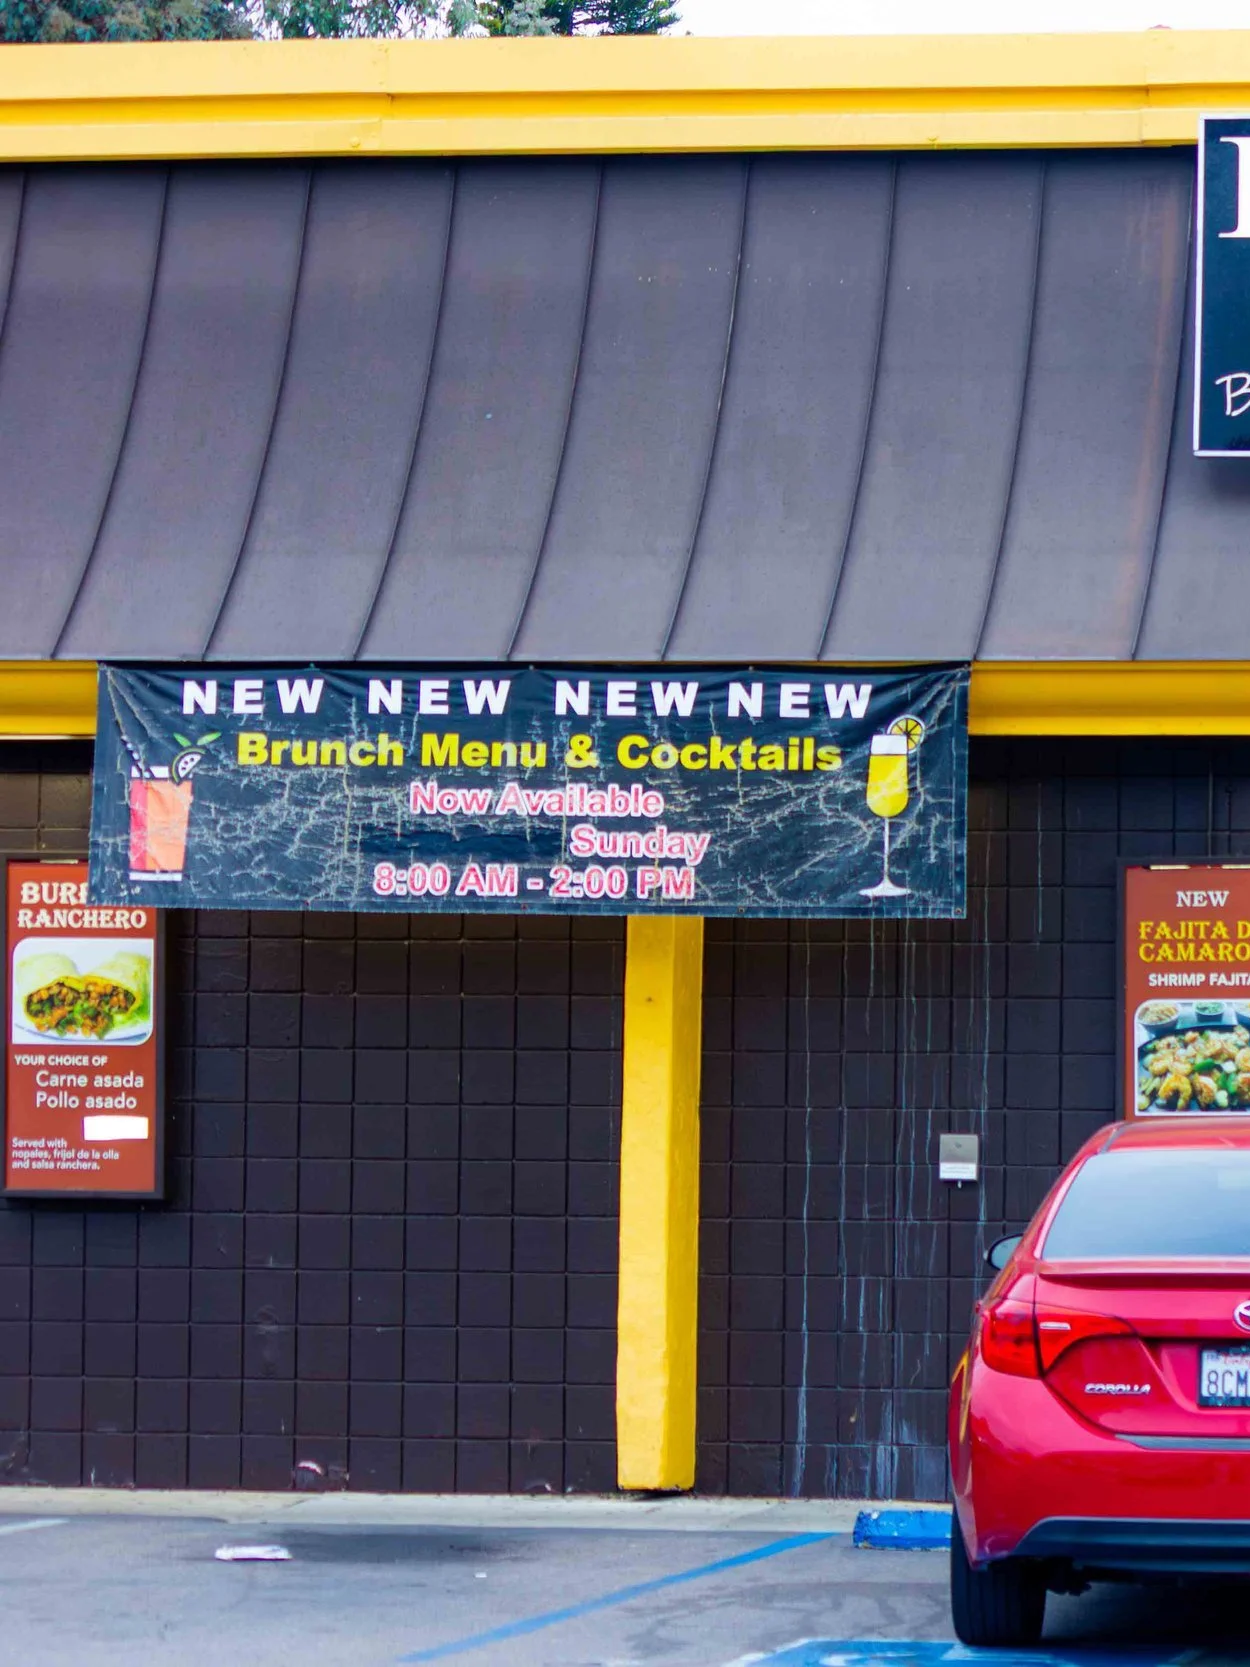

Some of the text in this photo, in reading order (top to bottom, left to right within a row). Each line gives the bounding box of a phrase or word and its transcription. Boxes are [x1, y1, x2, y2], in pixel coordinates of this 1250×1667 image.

[182, 679, 872, 719] NEW NEW NEW NEW
[237, 731, 843, 772] Brunch Menu & Cocktails
[410, 781, 665, 818] Now Available
[570, 824, 711, 866] Sunday
[373, 863, 696, 899] 8:00 AM - 2:00 PM
[1176, 890, 1229, 907] NEW
[17, 907, 147, 929] RANCHERO
[1138, 920, 1230, 941] FAJITA
[1148, 973, 1205, 987] SHRIMP
[14, 1054, 108, 1067] YOUR CHOICE OF
[36, 1070, 144, 1088] Carne asada
[36, 1091, 137, 1109] Pollo asado
[12, 1138, 68, 1148] Served with
[77, 1149, 90, 1159] de
[12, 1159, 29, 1169] and
[32, 1159, 54, 1169] salsa
[1084, 1383, 1151, 1395] COROLLA
